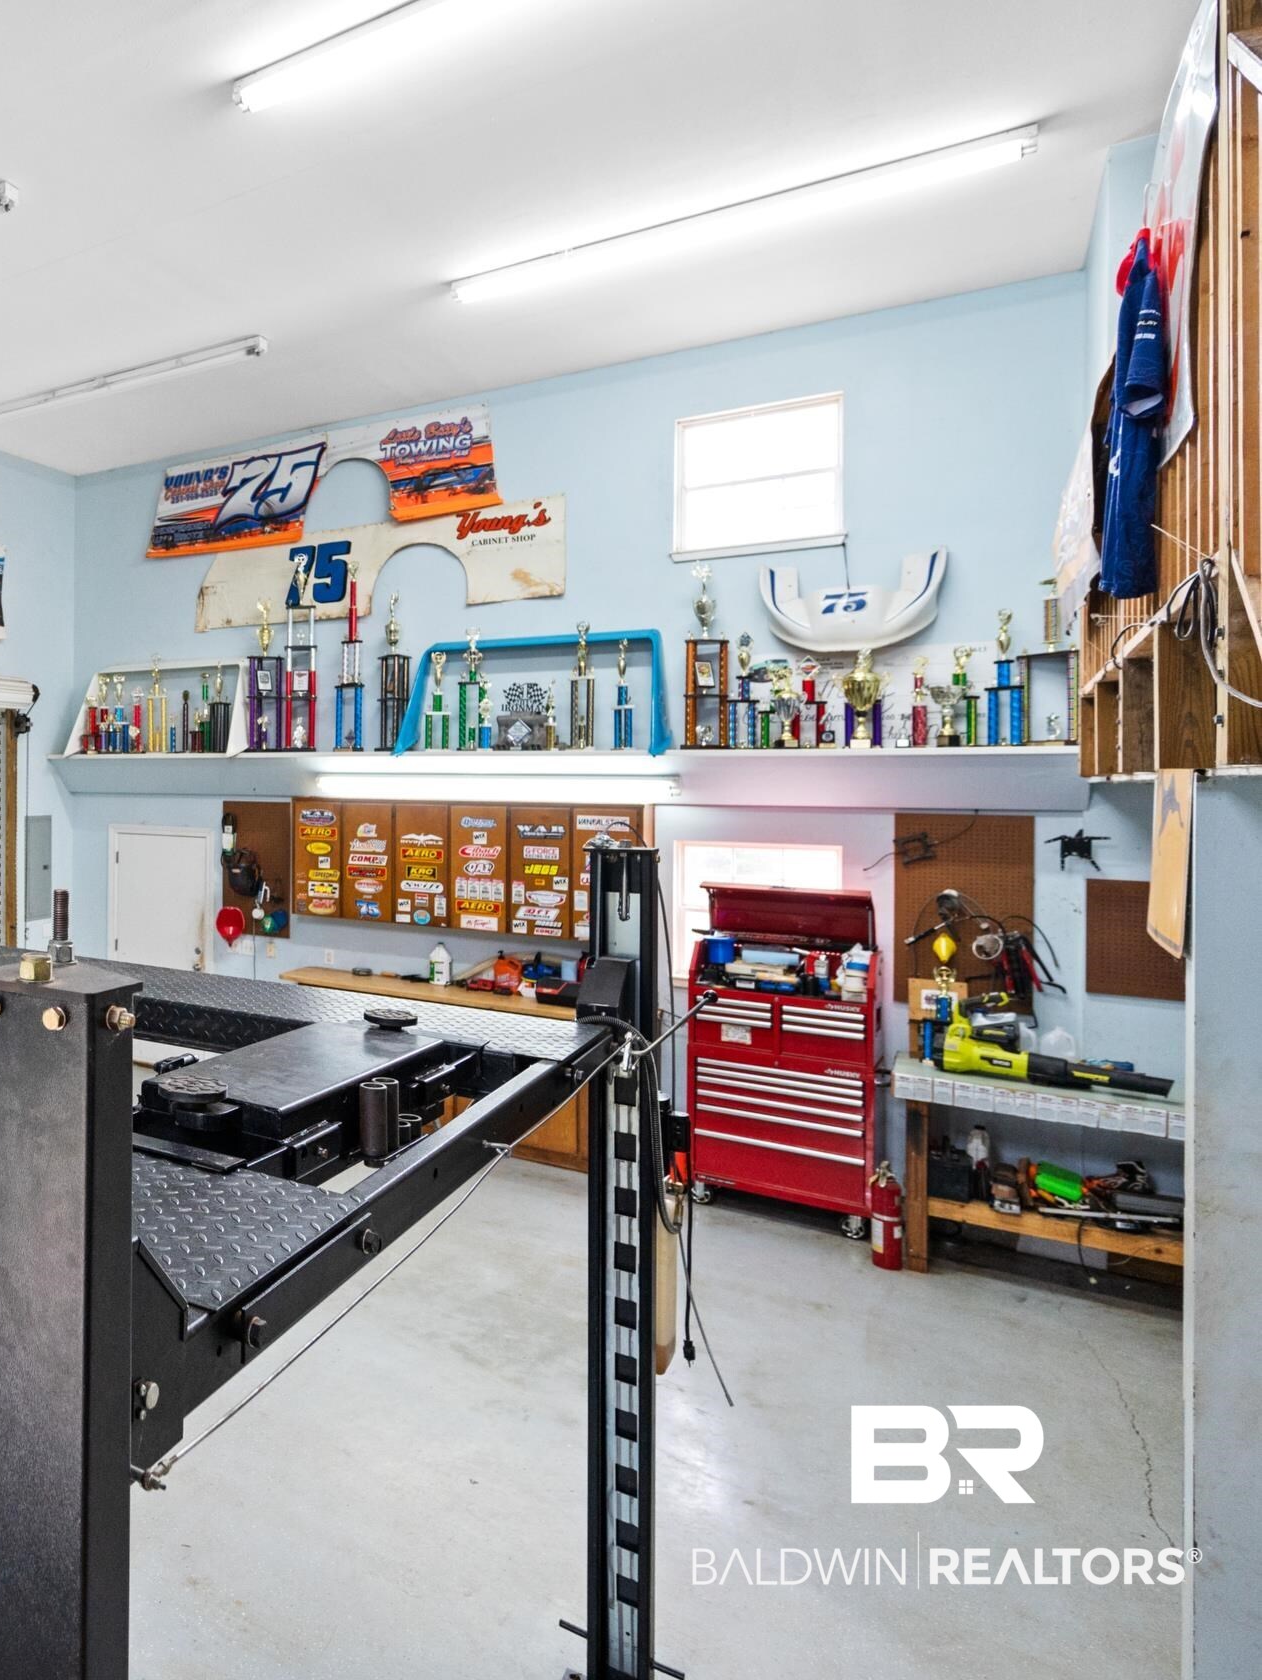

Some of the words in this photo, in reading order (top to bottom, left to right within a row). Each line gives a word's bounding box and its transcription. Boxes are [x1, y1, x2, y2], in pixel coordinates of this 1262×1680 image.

[379, 433, 472, 461] TOWING
[163, 465, 230, 489] YOUNG'S
[214, 442, 327, 532] 75
[456, 501, 551, 540] Young's
[471, 536, 509, 546] CABINET
[511, 533, 536, 543] SHOP
[285, 540, 351, 606] 75
[821, 591, 869, 614] 75
[304, 827, 333, 837] AERO
[351, 855, 379, 864] COMP
[405, 848, 438, 859] AERO
[524, 864, 559, 876] JEGS
[355, 899, 382, 918] 75
[460, 902, 495, 912] AERO
